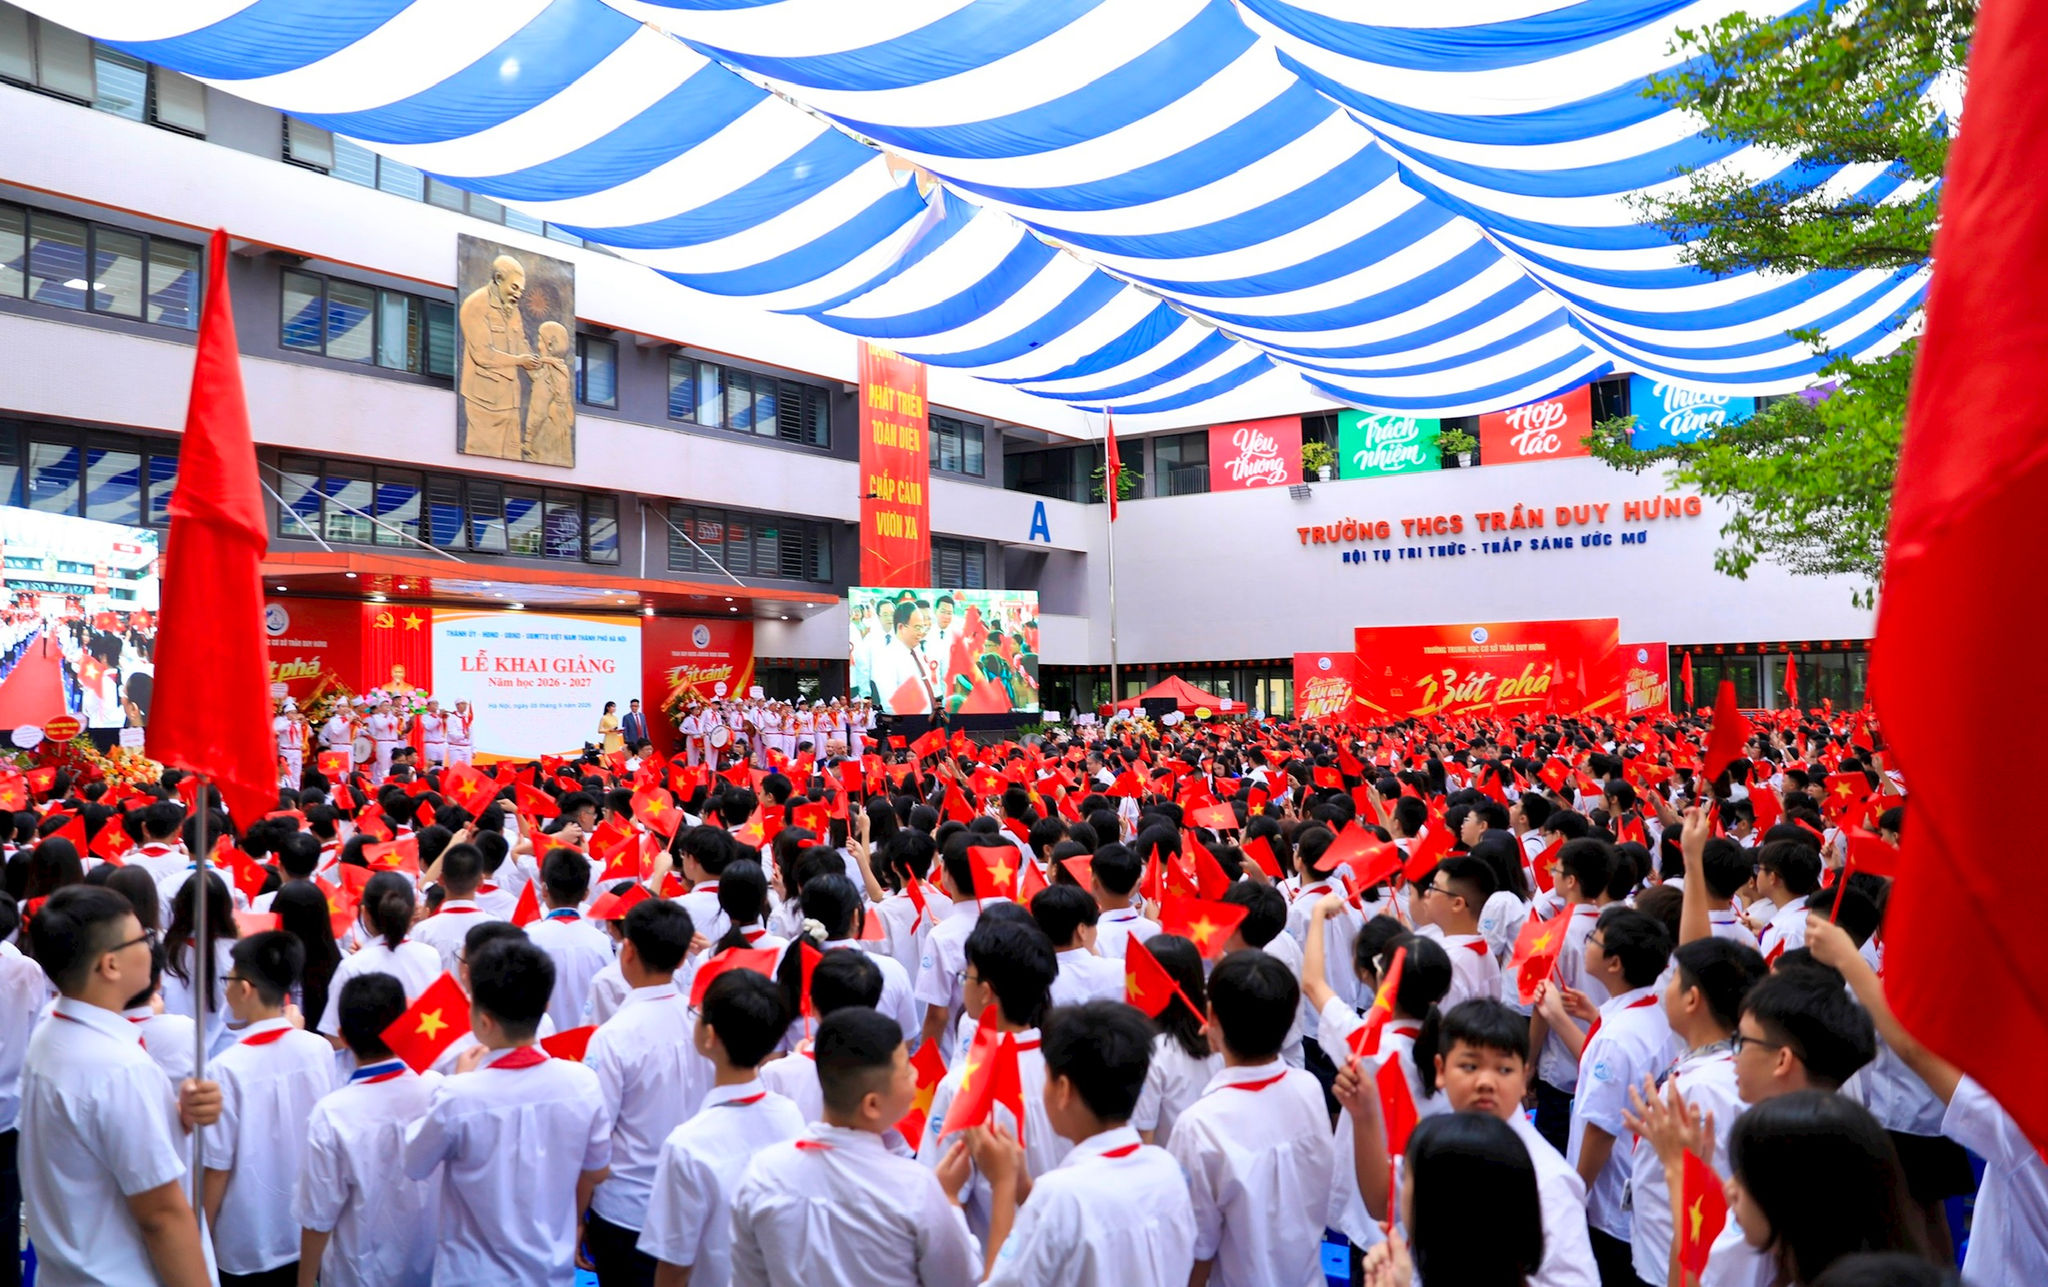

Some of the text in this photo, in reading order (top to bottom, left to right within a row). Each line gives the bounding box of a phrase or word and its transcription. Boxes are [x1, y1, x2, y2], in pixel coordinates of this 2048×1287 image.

[869, 380, 923, 418] PHÁT TRIỂN
[872, 415, 920, 456] TOÀN DIỆN
[1356, 413, 1420, 449] Trách
[1505, 401, 1568, 437] Hợp
[1233, 428, 1279, 459] Yêu
[1353, 442, 1427, 471] nhiệm
[1224, 457, 1288, 487] thương
[897, 475, 923, 506] CÁNH
[876, 510, 919, 540] VƯƠN XA
[1029, 500, 1051, 543] A
[1297, 494, 1703, 545] TRƯỜNG THCS TRẦN DUY HƯNG
[1343, 549, 1367, 565] HỘI
[1373, 548, 1391, 563] TỤ
[1399, 546, 1422, 560] TRI
[1428, 542, 1466, 558] THỨC
[1481, 536, 1523, 554] THẮP
[1530, 535, 1573, 551] SÁNG
[1581, 530, 1613, 547] ƯỚC
[1622, 529, 1648, 545] MƠ
[461, 648, 617, 674] LỄ KHAI GIẢNG
[488, 677, 513, 688] Năm
[516, 677, 534, 689] học
[537, 677, 560, 688] 2026
[569, 677, 592, 688] 2027
[1412, 662, 1553, 715] Bút phá
